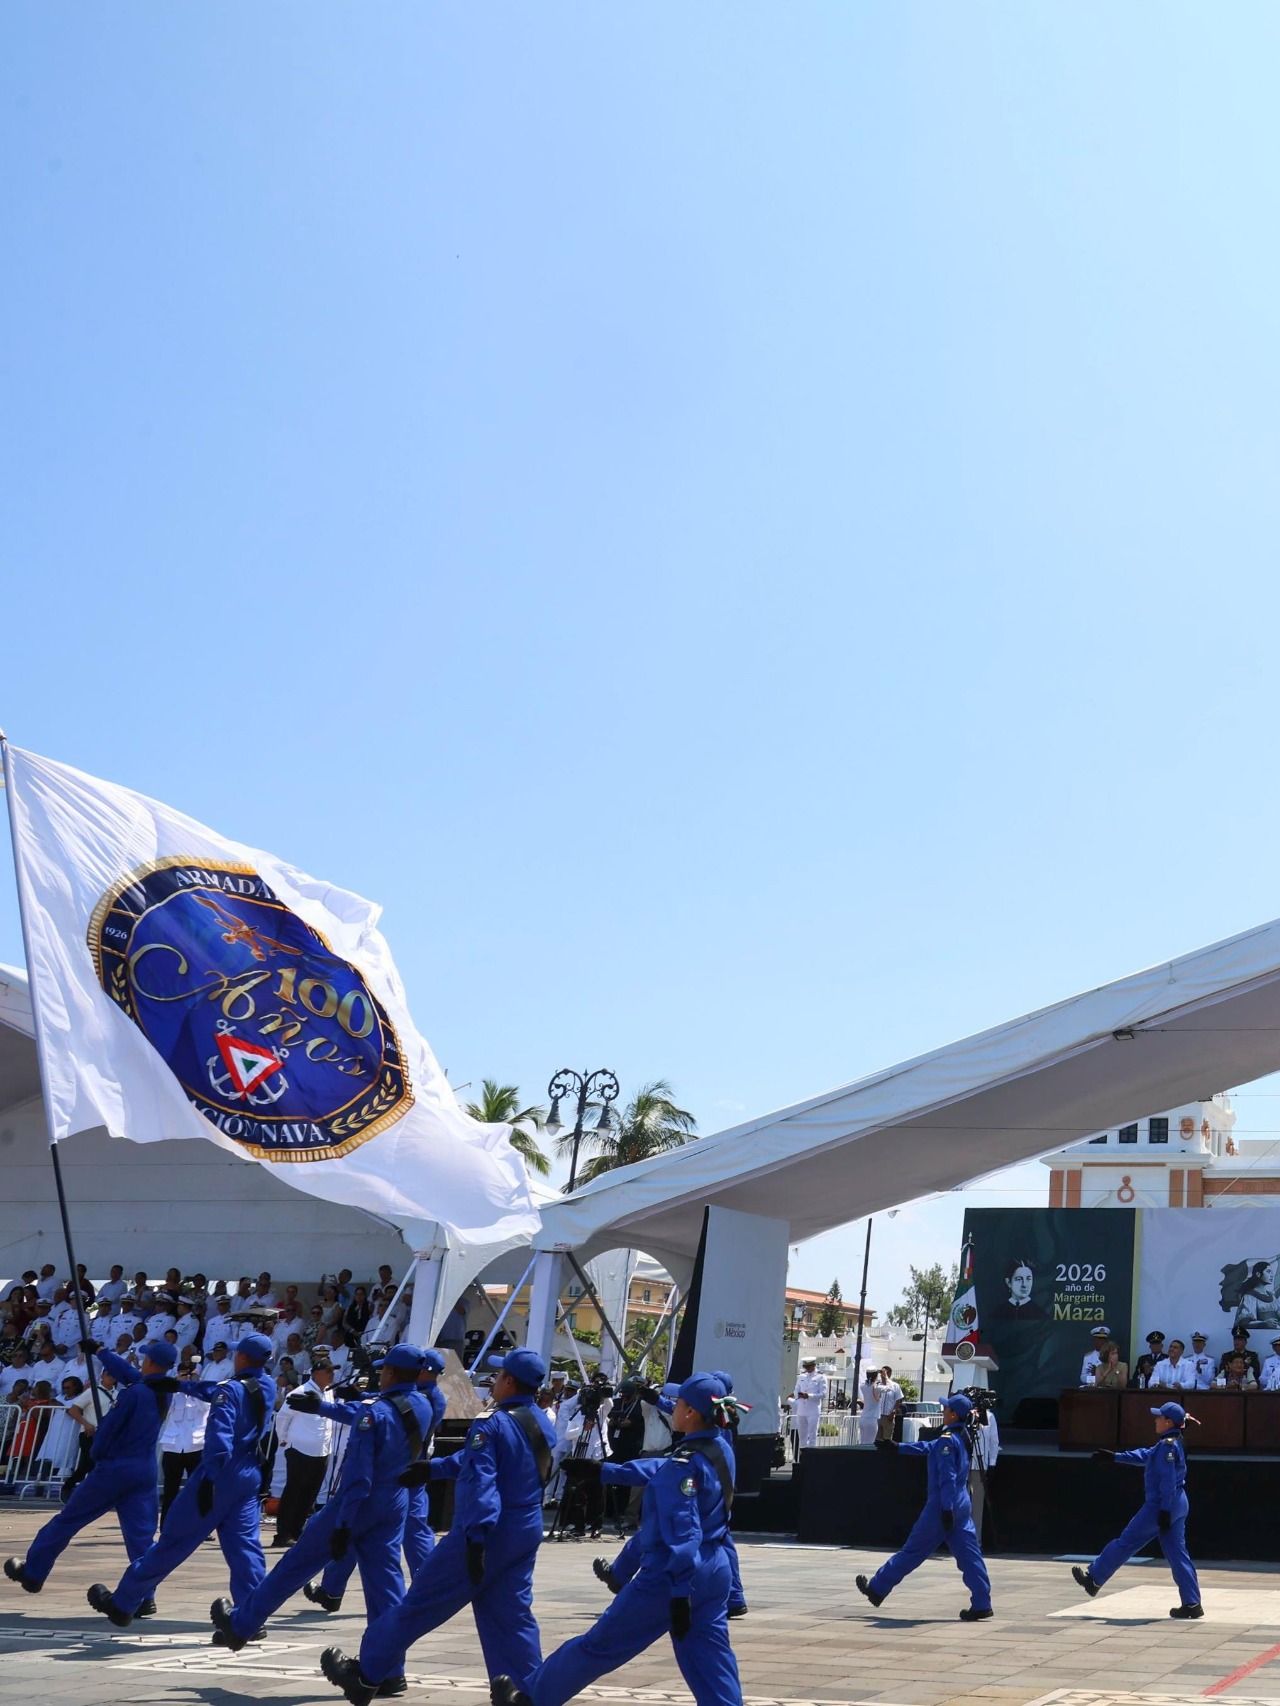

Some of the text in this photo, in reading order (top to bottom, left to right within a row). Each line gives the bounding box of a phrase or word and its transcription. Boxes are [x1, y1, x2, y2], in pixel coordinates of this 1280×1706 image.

[174, 870, 272, 899] ARMADA
[105, 926, 127, 940] 1926
[272, 967, 375, 1038] 100
[1055, 1263, 1106, 1281] 2026
[1065, 1283, 1095, 1292] año de
[1054, 1292, 1105, 1304] Margarita
[1053, 1303, 1105, 1321] Maza
